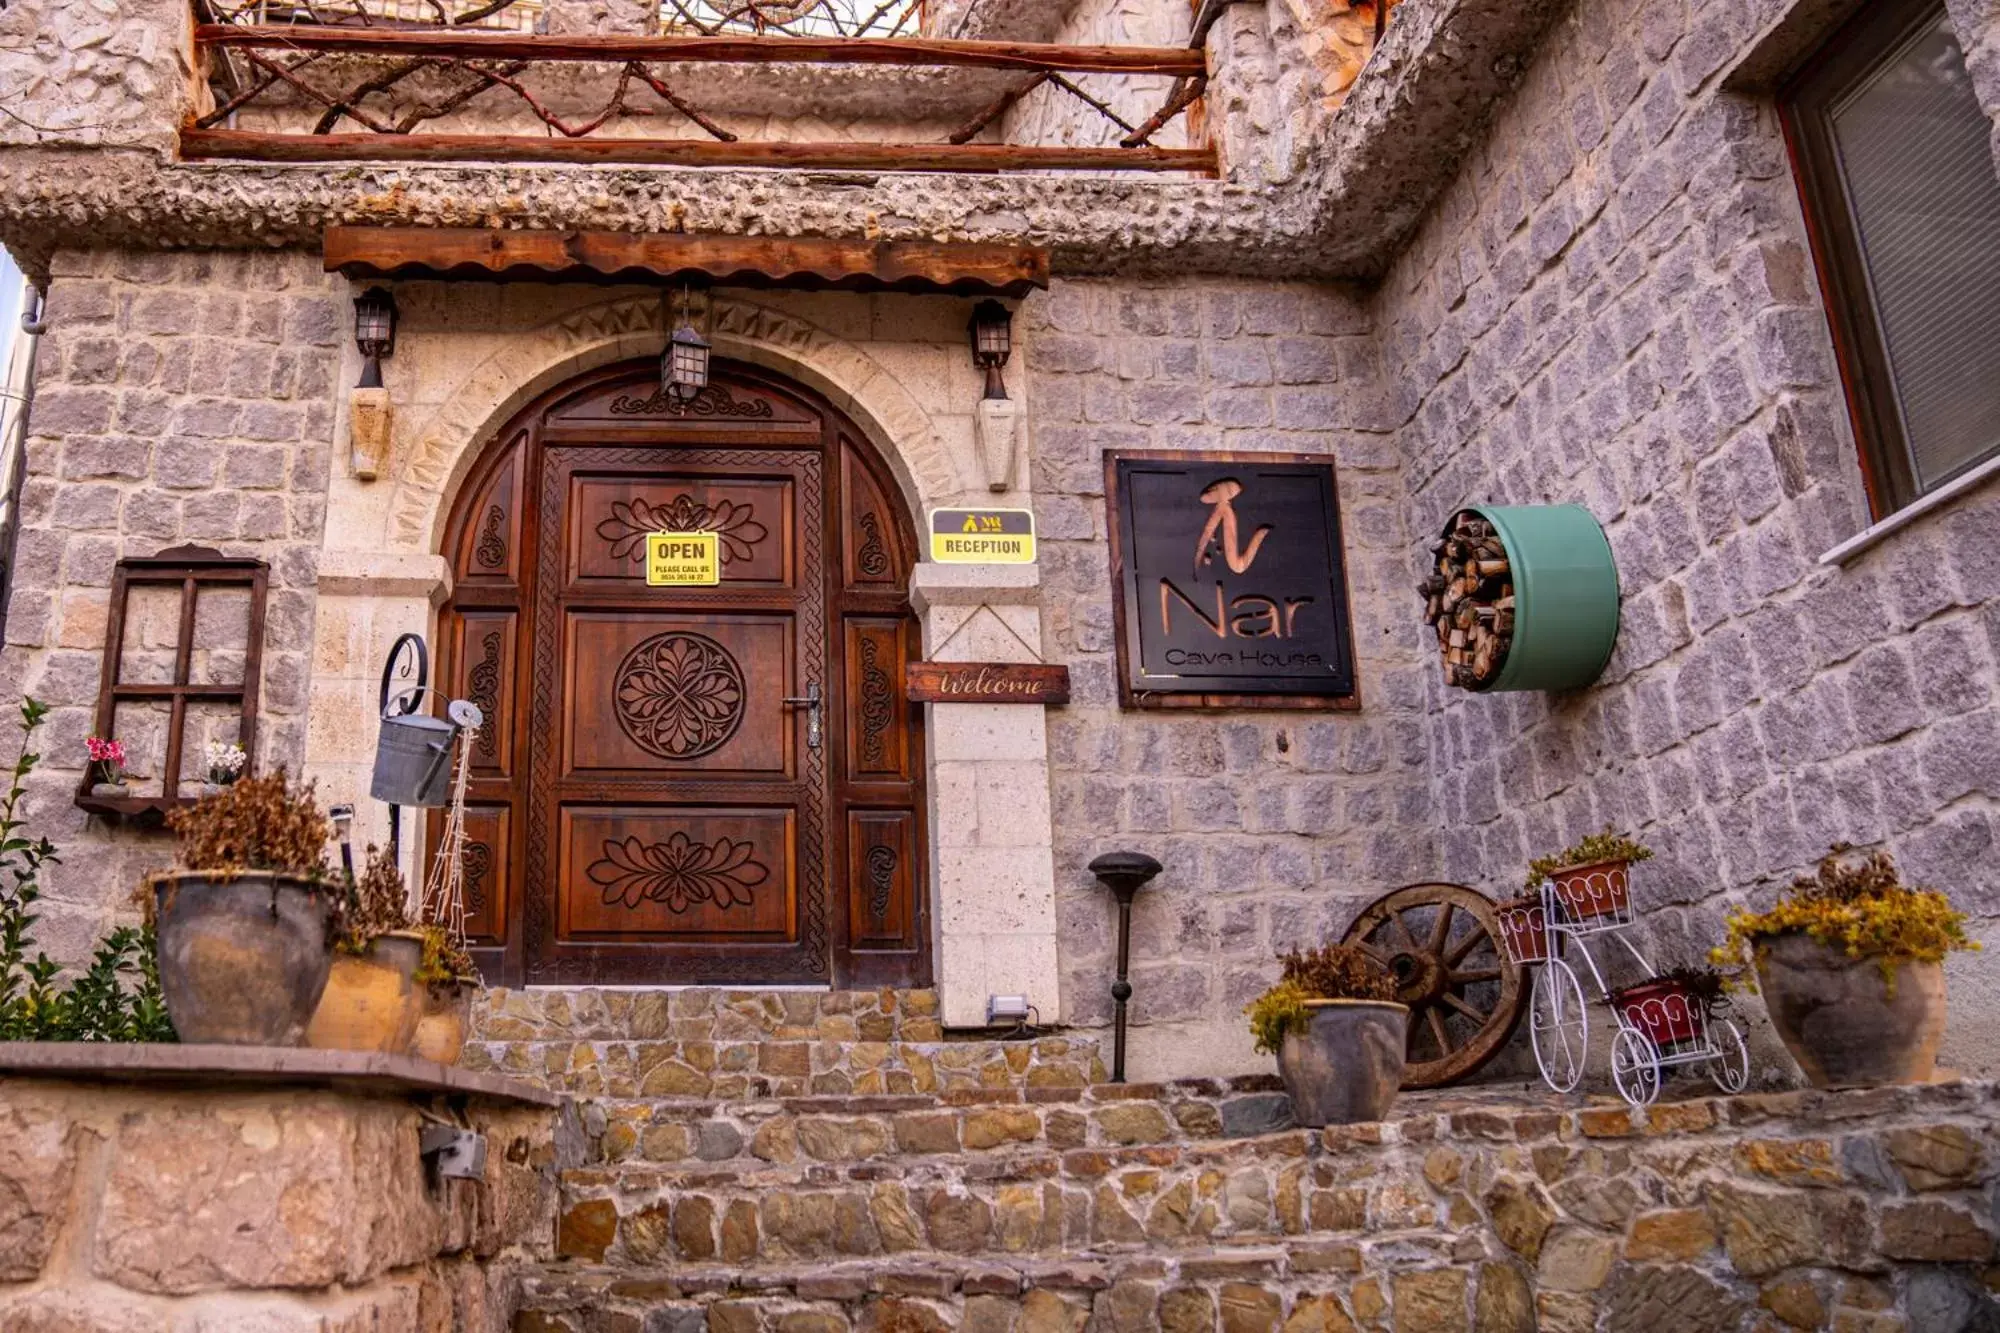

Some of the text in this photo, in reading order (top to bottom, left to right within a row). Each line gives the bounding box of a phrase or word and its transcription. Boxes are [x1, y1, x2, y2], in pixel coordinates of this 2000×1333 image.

[658, 543, 705, 559] OPEN
[945, 540, 1021, 554] RECEPTION
[655, 565, 710, 573] PLEASE CALL US
[1160, 576, 1315, 639] Nar
[1165, 649, 1322, 667] Cave House
[940, 667, 1052, 694] Welcome
